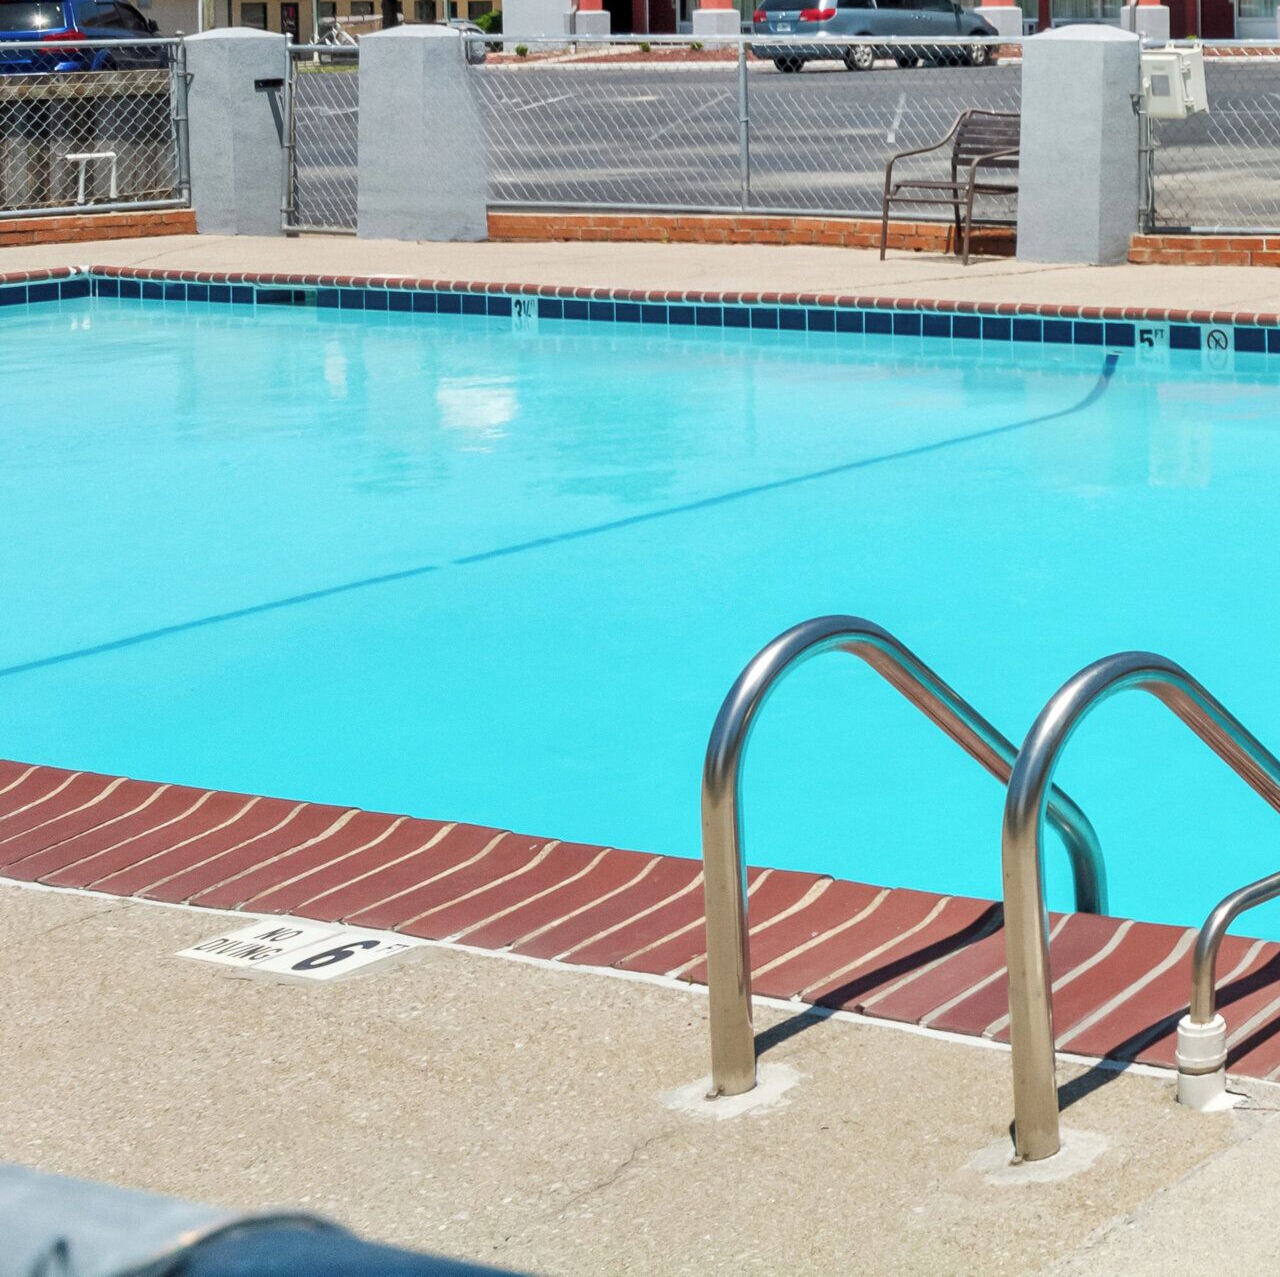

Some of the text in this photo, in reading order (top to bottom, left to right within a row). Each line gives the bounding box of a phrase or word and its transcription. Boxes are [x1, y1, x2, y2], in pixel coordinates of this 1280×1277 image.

[1139, 329, 1165, 348] 5 FT
[254, 927, 304, 942] NO
[192, 938, 283, 961] DIVING
[291, 940, 381, 971] 6
